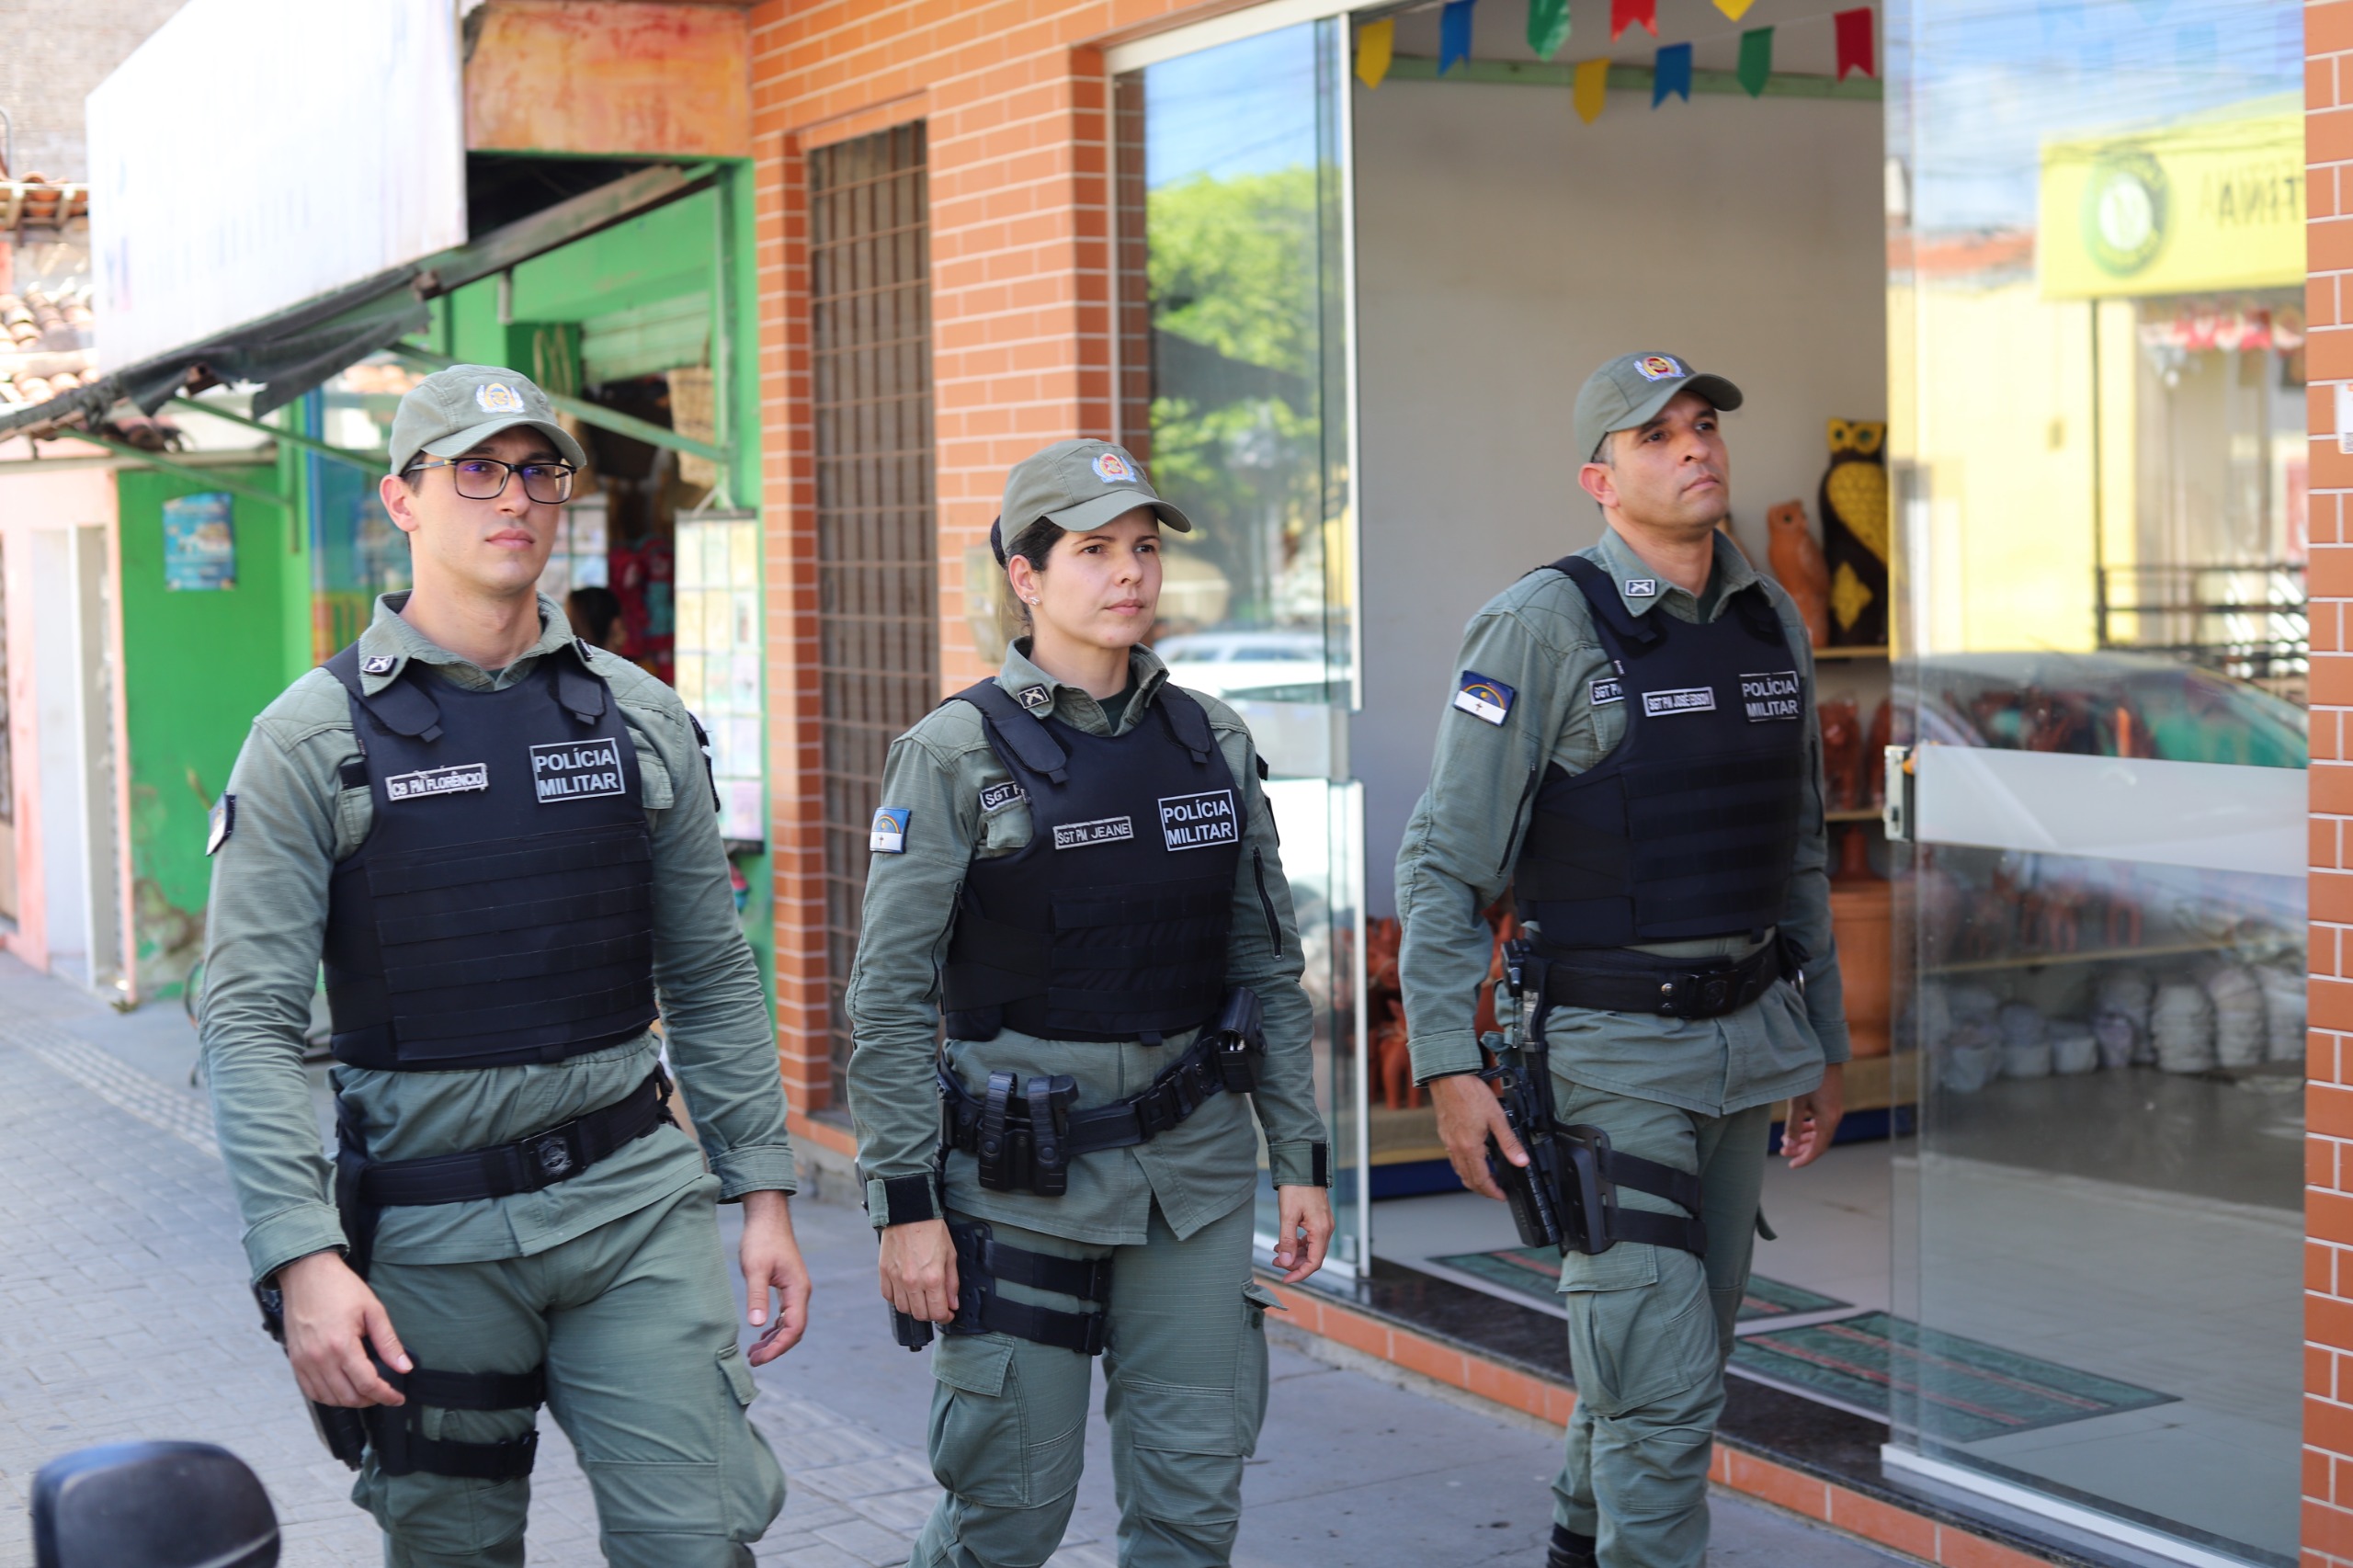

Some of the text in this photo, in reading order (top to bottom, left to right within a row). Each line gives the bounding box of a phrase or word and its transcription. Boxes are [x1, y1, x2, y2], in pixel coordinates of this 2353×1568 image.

[1595, 685, 1610, 699] SGT
[1742, 677, 1797, 697] POLÍCIA
[1745, 699, 1799, 717] MILITAR
[534, 747, 616, 772] POLÍCIA
[538, 772, 619, 797] MILITAR
[984, 786, 1010, 805] SGT
[1163, 799, 1232, 824] POLÍCIA
[1057, 823, 1130, 844] SGT PM JEANE
[1166, 822, 1233, 846] MILITAR
